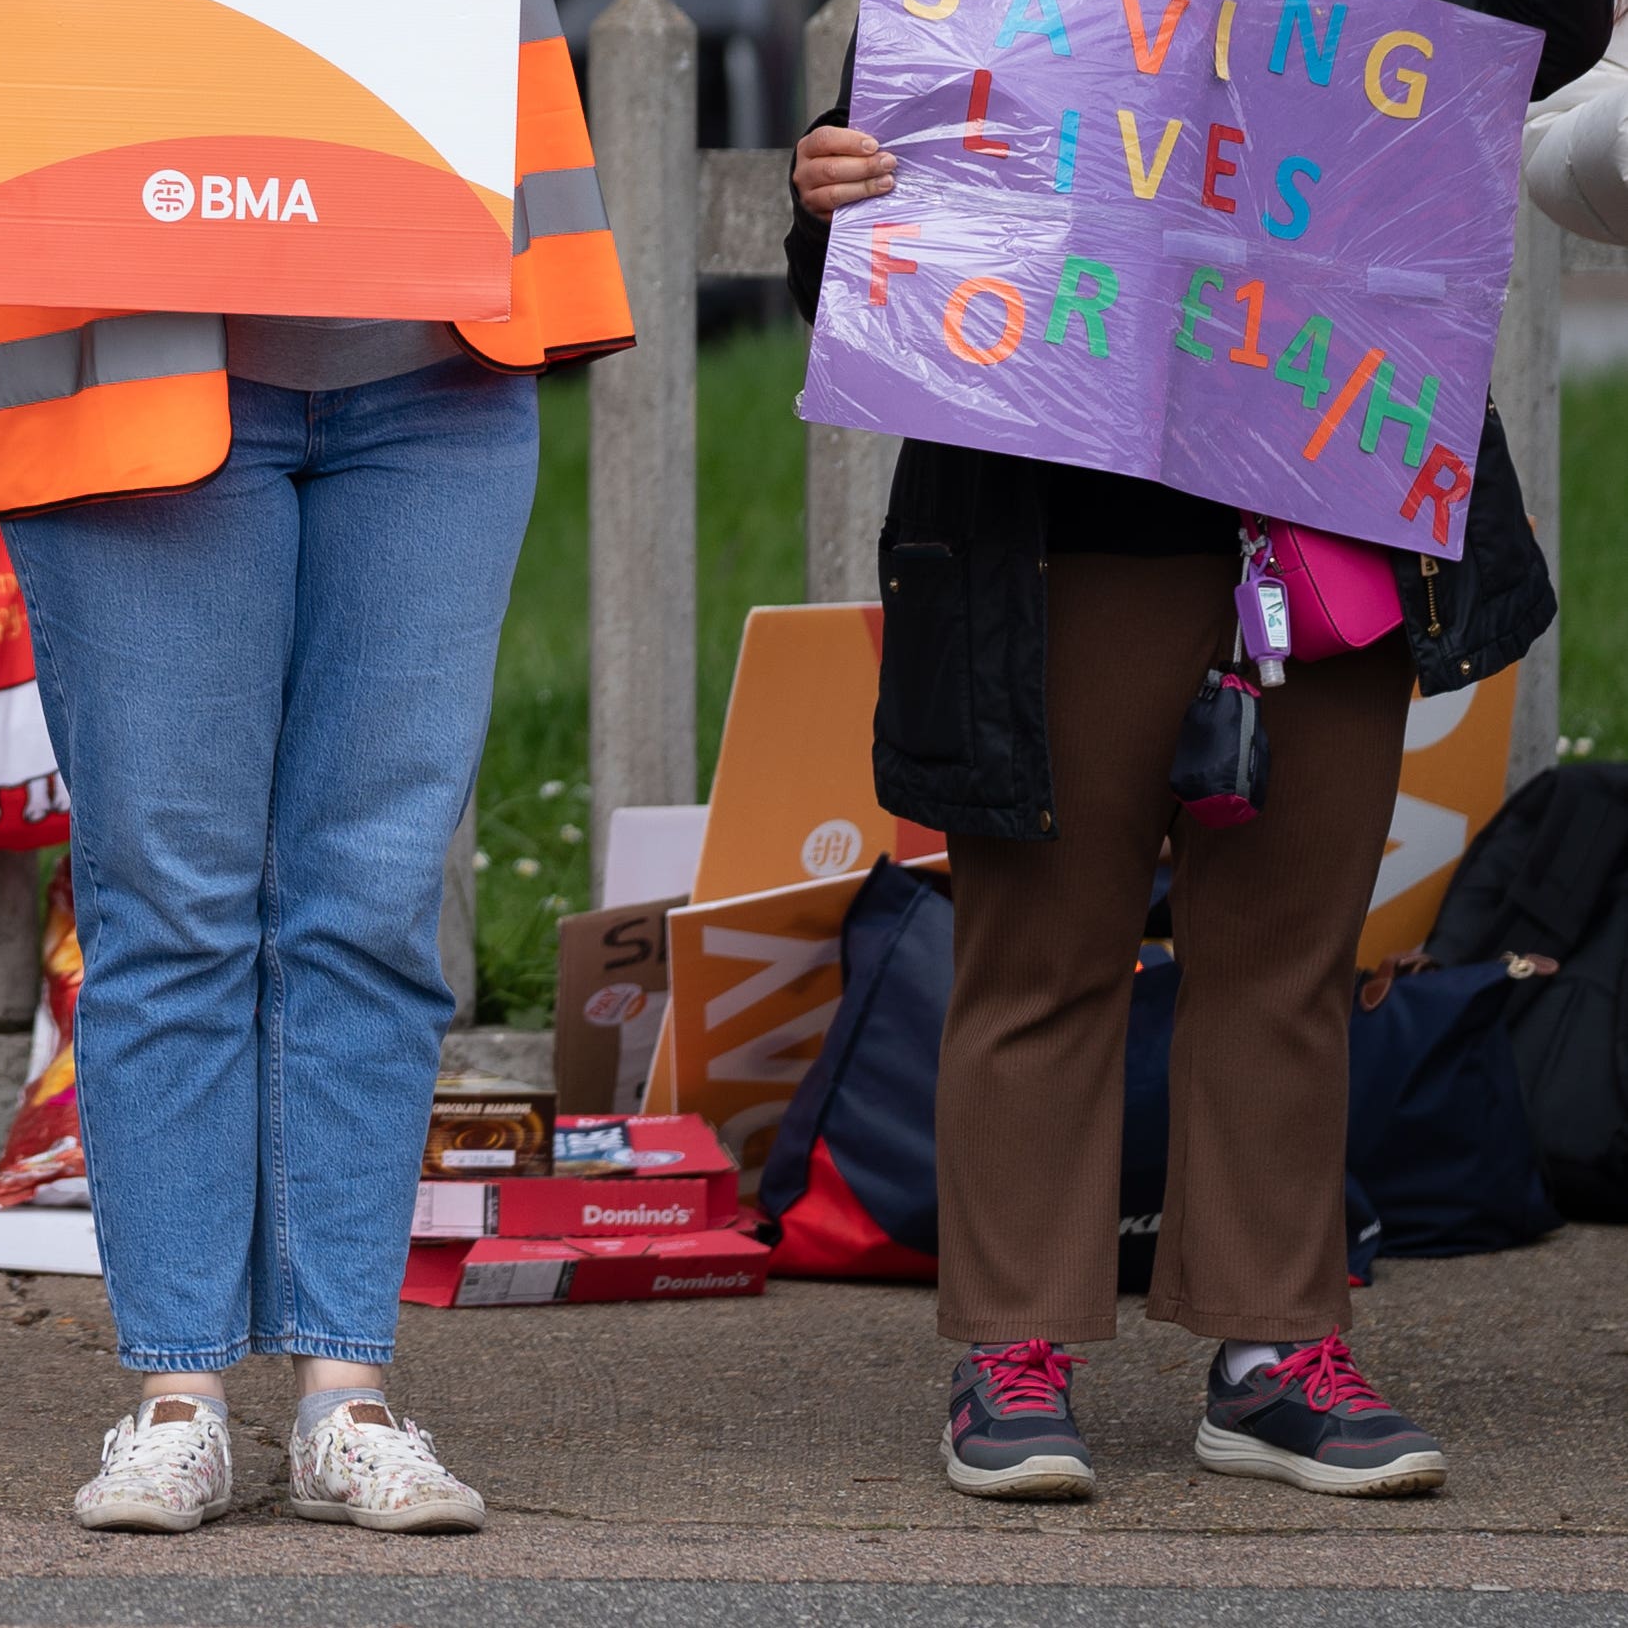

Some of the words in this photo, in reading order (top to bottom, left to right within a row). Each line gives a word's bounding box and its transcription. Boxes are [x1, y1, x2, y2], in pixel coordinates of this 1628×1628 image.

[963, 69, 1321, 241] LIVES
[202, 176, 318, 223] BMA
[868, 223, 1120, 366] FOR
[1174, 265, 1473, 546] £14/HR
[582, 1203, 690, 1227] Domino's
[652, 1271, 752, 1293] Domino's
